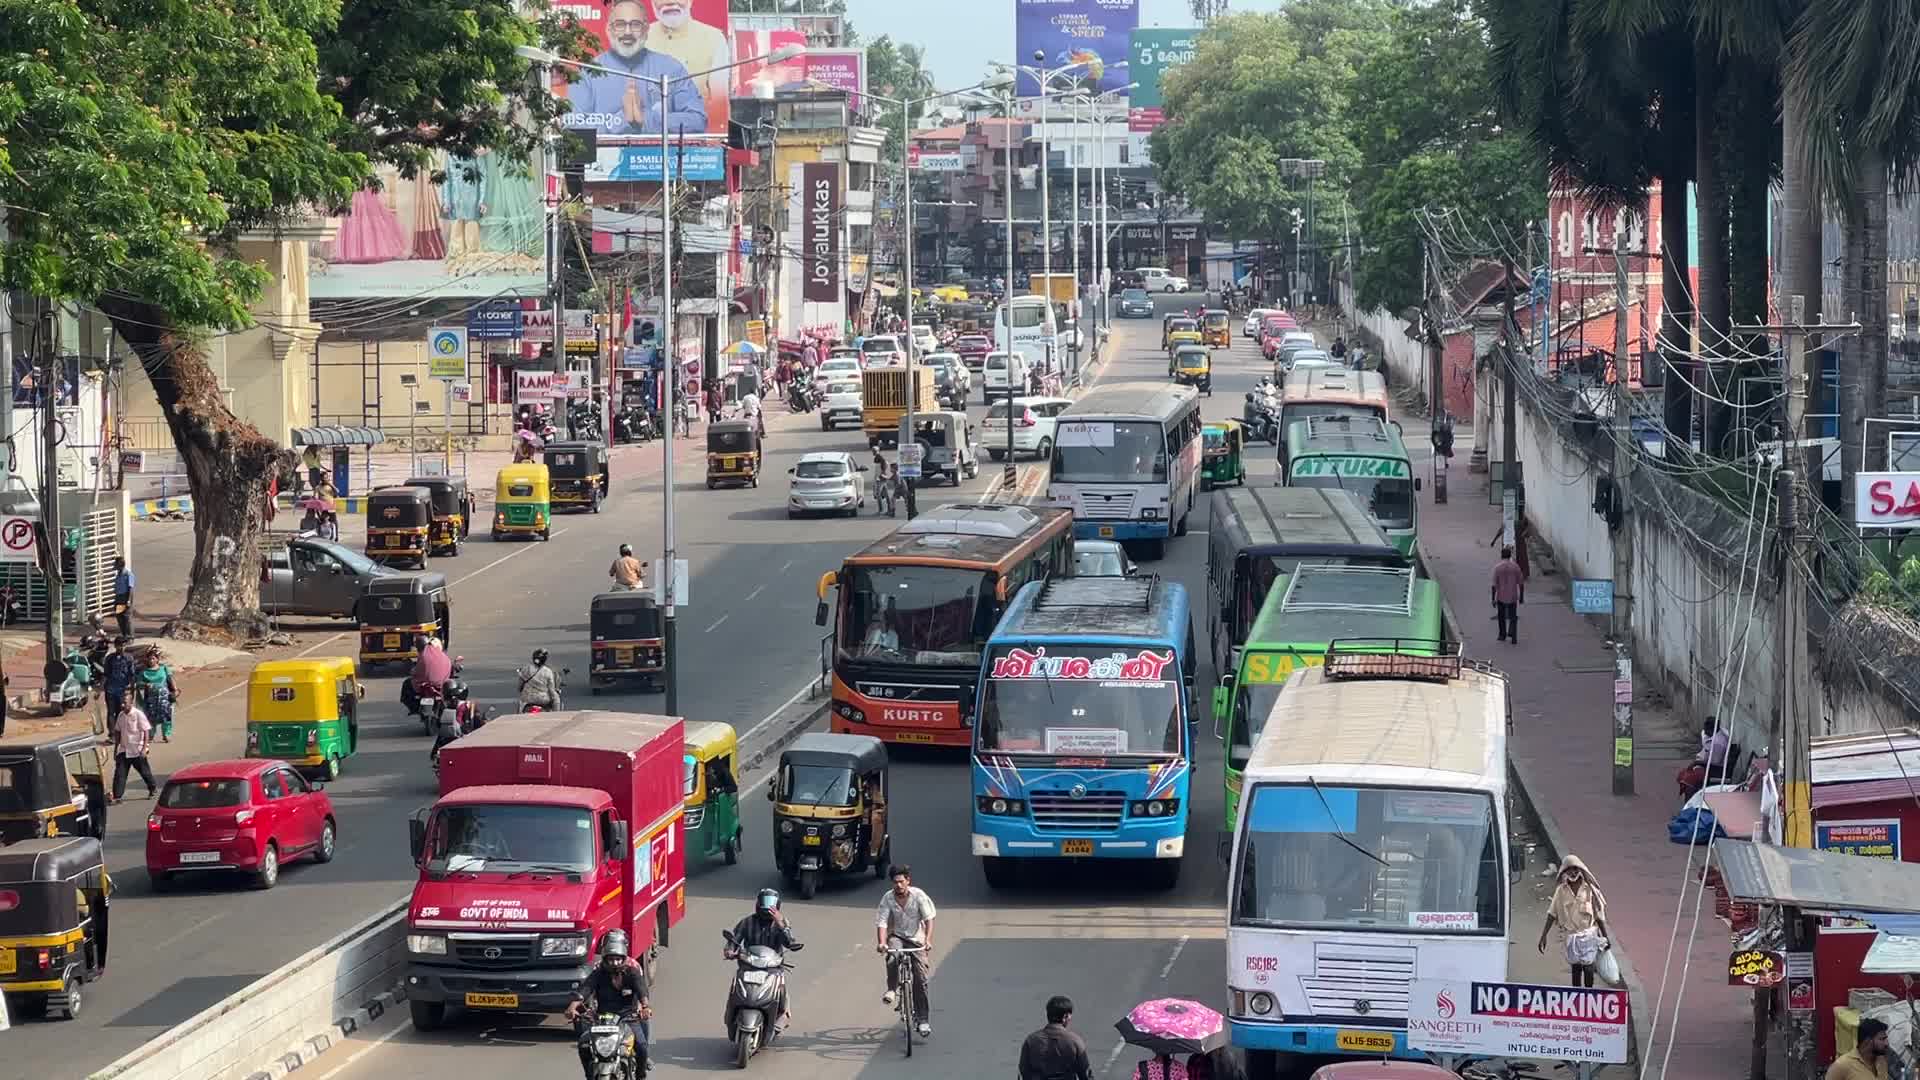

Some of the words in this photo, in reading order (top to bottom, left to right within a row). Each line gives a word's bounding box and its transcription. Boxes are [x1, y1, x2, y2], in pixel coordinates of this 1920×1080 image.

[1071, 27, 1105, 38] SPEED
[812, 180, 830, 286] Joyalukkas
[1295, 458, 1404, 477] ATTUKAL
[1580, 588, 1605, 597] BUS
[1575, 598, 1612, 607] STOP
[883, 709, 944, 721] KURTC
[524, 754, 545, 762] MAIL
[460, 907, 487, 919] GOVT
[489, 908, 503, 919] OF
[503, 908, 529, 920] INDIA
[547, 910, 570, 919] MAIL
[1736, 951, 1763, 965] ചായ
[1477, 986, 1510, 1012] NO
[1517, 988, 1620, 1020] PARKING
[1409, 1020, 1482, 1034] SANGEETH
[1508, 1043, 1538, 1053] INTUC
[1540, 1046, 1561, 1055] East
[1563, 1047, 1583, 1056] Fort
[1585, 1049, 1605, 1058] Unit
